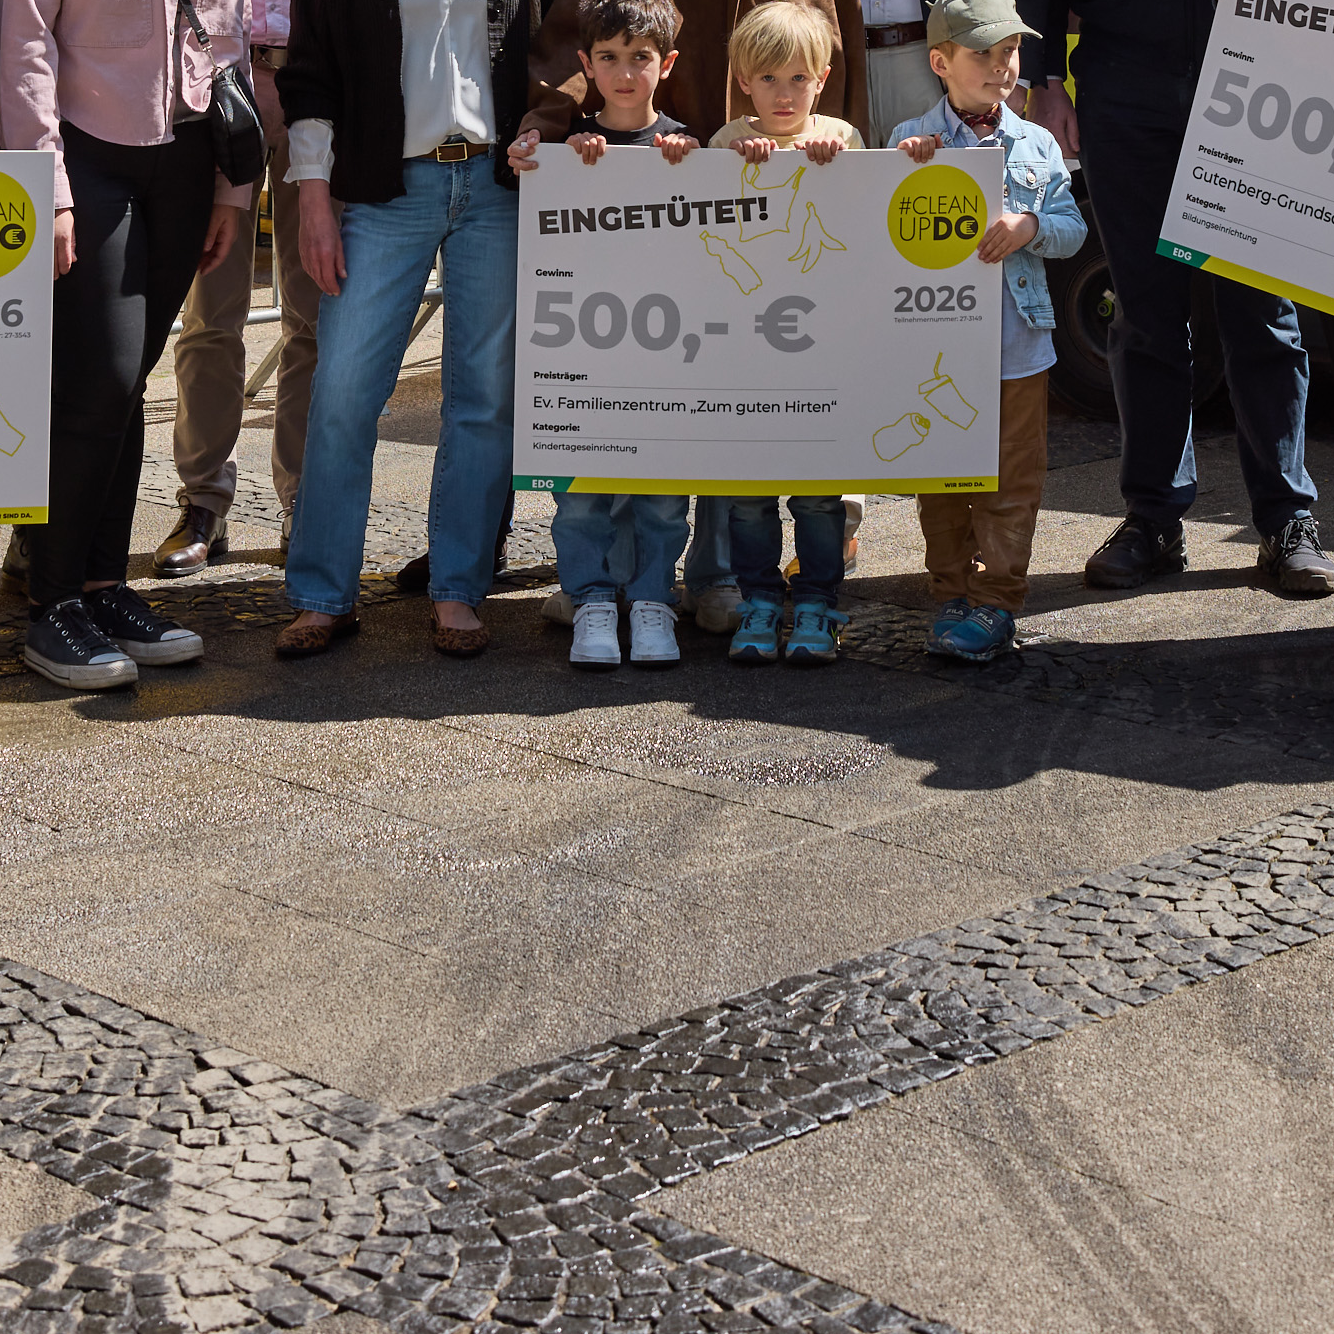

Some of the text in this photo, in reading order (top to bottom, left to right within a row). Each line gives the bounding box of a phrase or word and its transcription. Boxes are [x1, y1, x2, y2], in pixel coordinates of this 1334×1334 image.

[1222, 46, 1255, 64] Gewinn:
[1198, 143, 1244, 167] Preisträger:
[898, 194, 979, 216] #CLEAN
[1185, 193, 1226, 214] Kategorie:
[538, 195, 768, 235] EINGETÜTET!
[1181, 211, 1258, 245] Bildungseinrichtung
[1172, 247, 1192, 262] EDG
[535, 267, 573, 278] Gewinn:
[893, 285, 977, 313] 2026
[754, 295, 817, 353] €
[893, 316, 958, 324] Teilnehmernummer:
[533, 370, 588, 383] Preisträger:
[533, 396, 554, 410] Ev.
[557, 396, 687, 413] Familienzentrum
[735, 401, 780, 416] guten
[532, 422, 580, 434] Kategorie:
[532, 441, 638, 455] Kindertageseinrichtung
[531, 478, 555, 489] EDG
[3, 512, 19, 520] SIND
[20, 512, 33, 520] DA.
[978, 613, 993, 624] FILA
